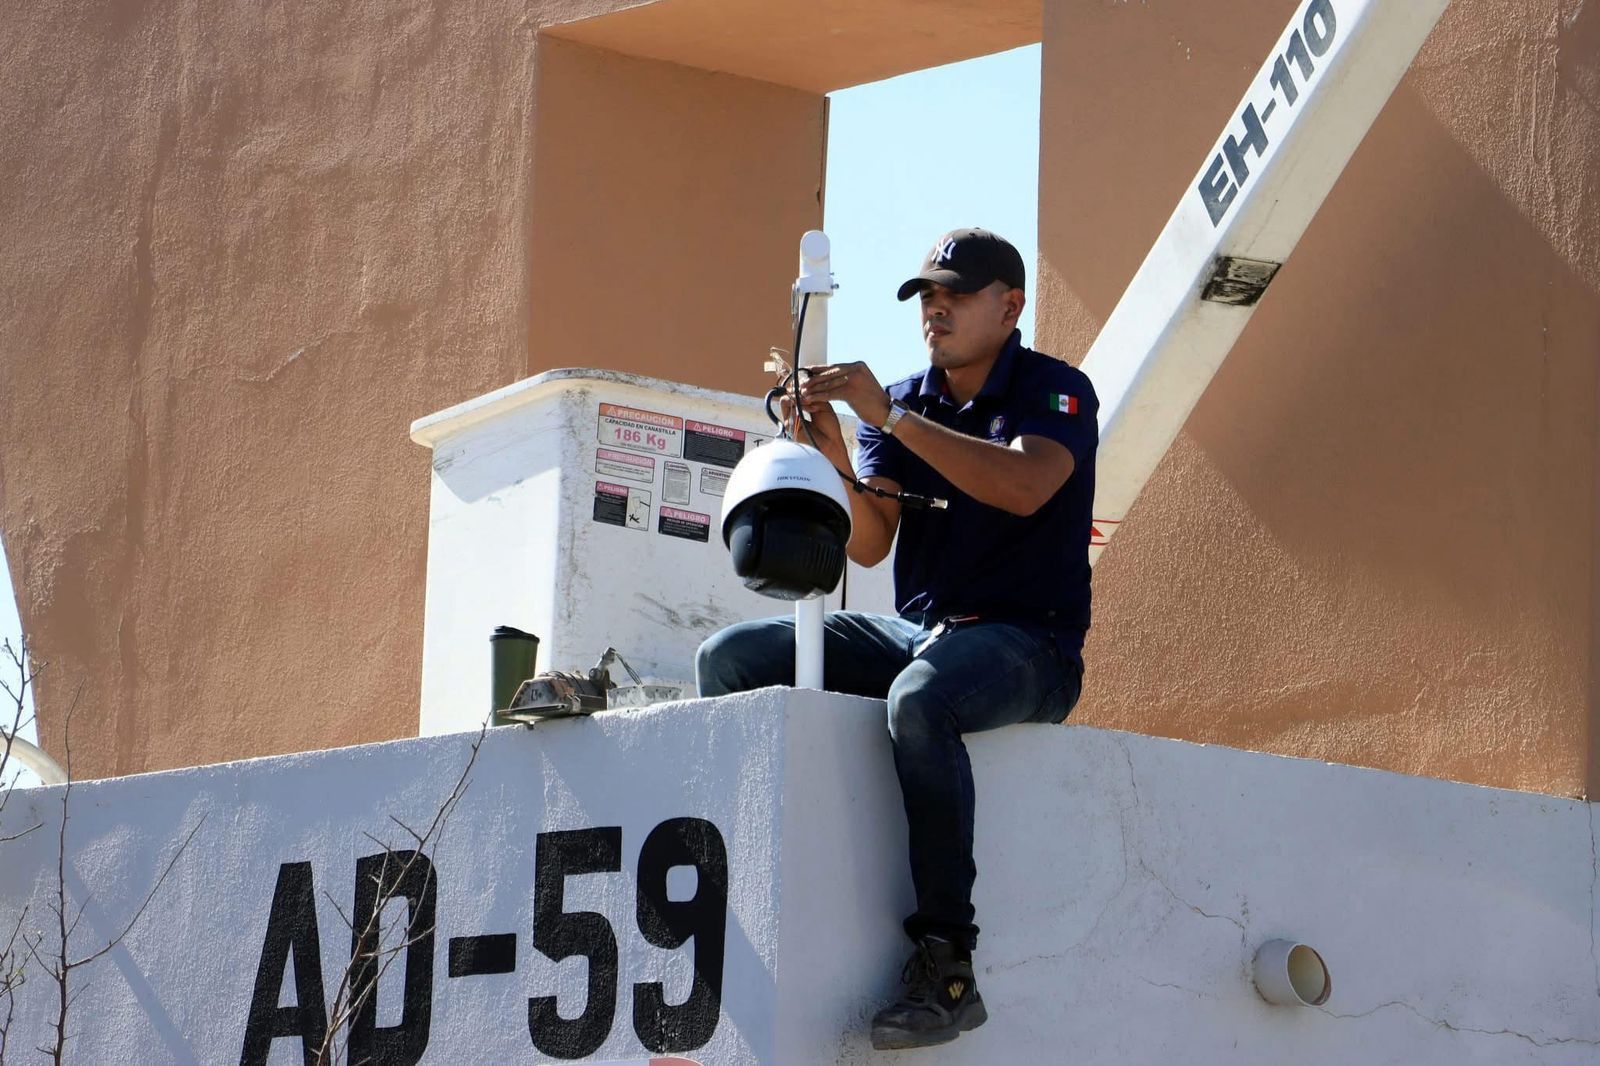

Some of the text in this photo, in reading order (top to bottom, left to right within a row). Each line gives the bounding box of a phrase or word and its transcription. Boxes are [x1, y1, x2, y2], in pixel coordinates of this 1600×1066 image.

[1198, 0, 1337, 228] EH-110
[605, 418, 635, 429] CAPACIDAD
[644, 424, 676, 436] CANASTILLA
[703, 425, 734, 437] PELIGRO
[614, 427, 641, 443] 186
[646, 433, 666, 450] Kg
[673, 511, 706, 522] PELIGRO
[239, 816, 729, 1066] AD-59
